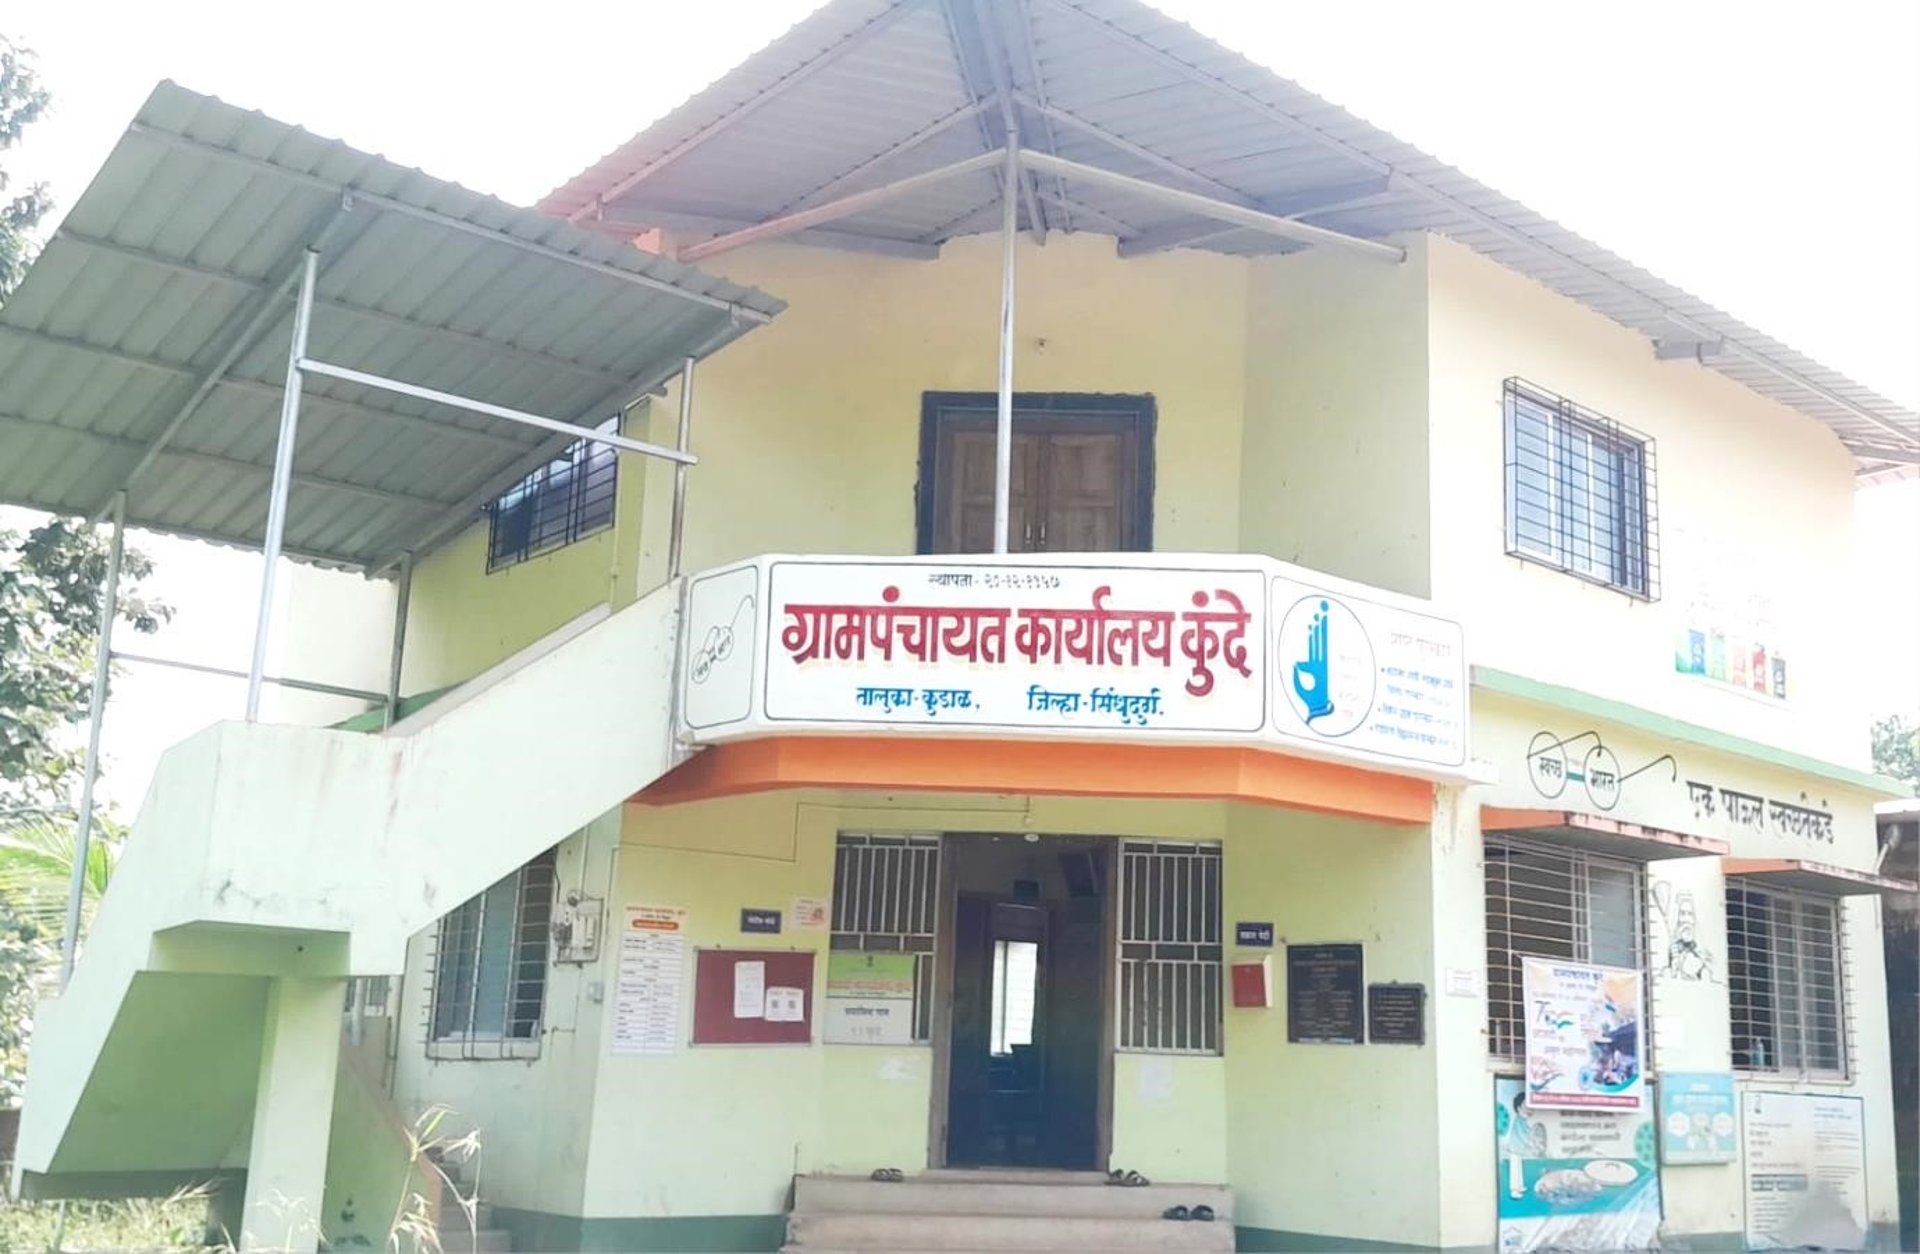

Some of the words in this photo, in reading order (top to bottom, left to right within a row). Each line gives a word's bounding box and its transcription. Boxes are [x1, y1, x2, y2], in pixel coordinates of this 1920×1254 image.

[782, 586, 1011, 665] ग्रामपंचायत
[1015, 586, 1176, 667] कार्यालय
[1181, 589, 1253, 697] कुंदे
[1686, 780, 1716, 819] एक
